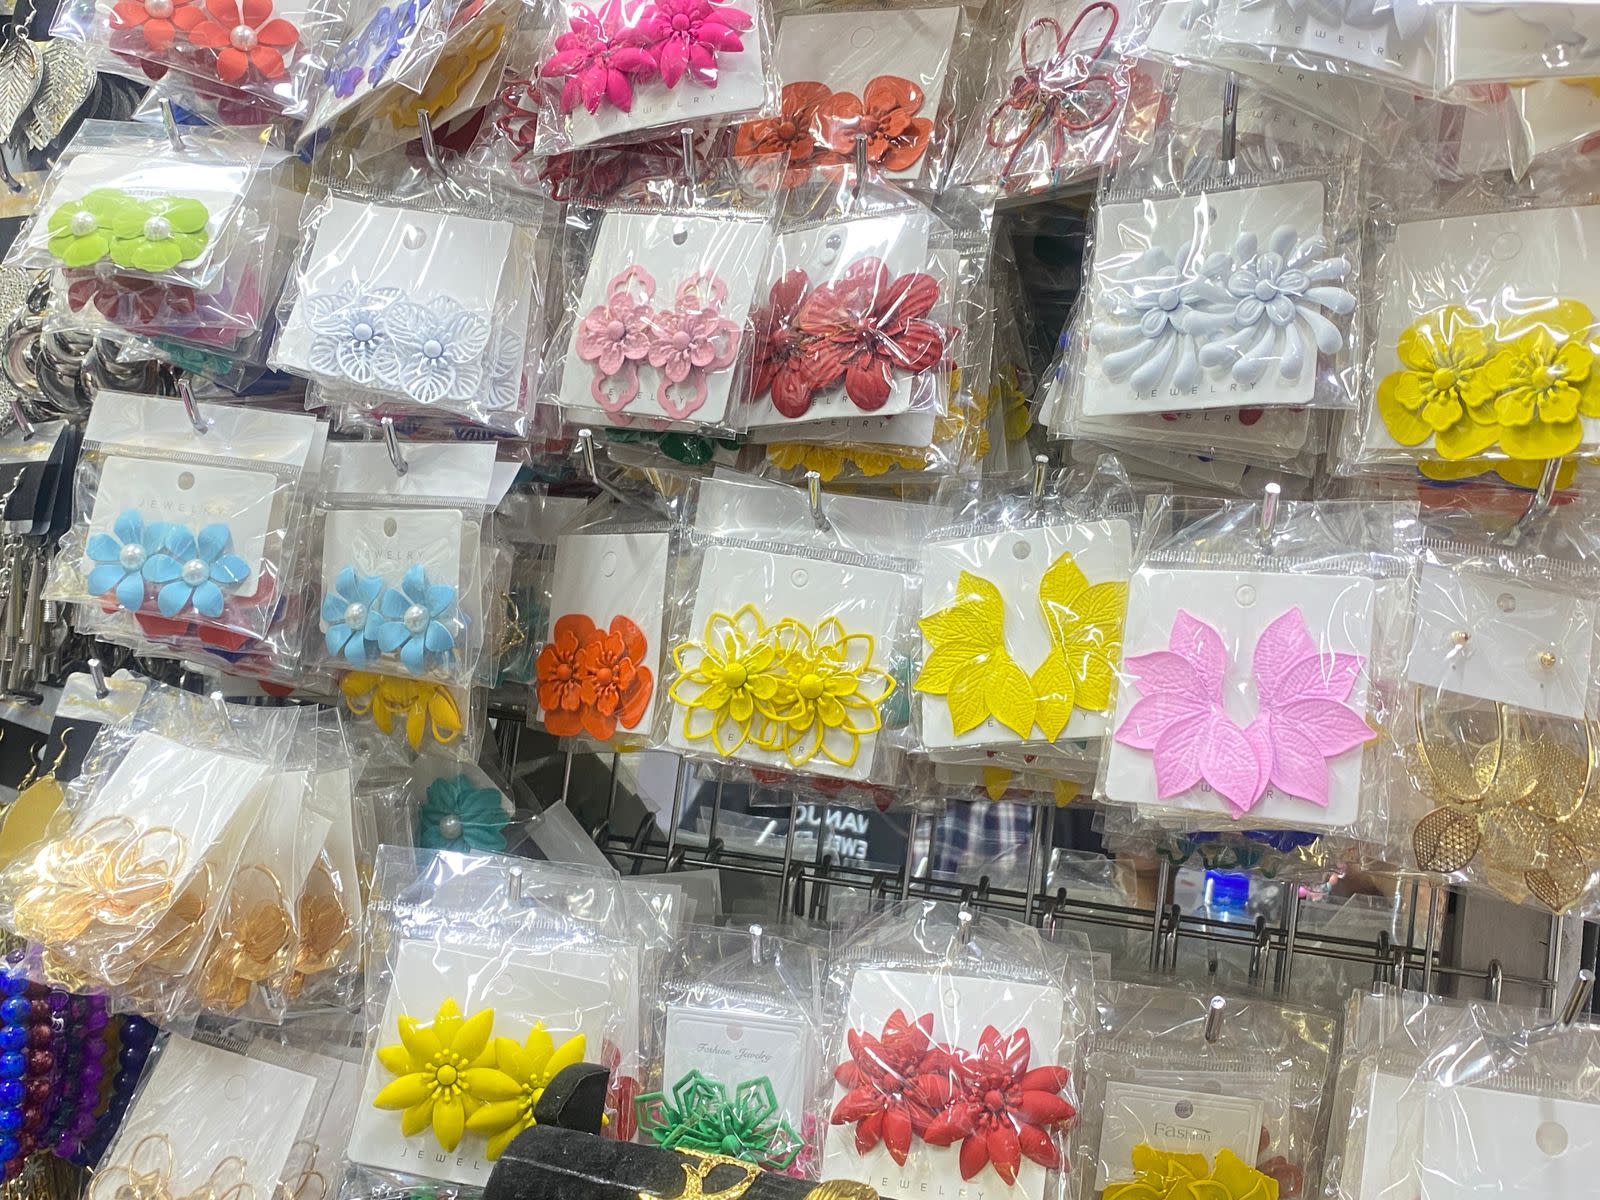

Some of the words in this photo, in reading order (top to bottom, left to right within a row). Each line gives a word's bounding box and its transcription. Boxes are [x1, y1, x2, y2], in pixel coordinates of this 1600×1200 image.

[1276, 25, 1403, 61] JEWELRY
[615, 94, 716, 121] JEWELRY
[1135, 381, 1257, 401] JEWELRY
[696, 1042, 731, 1056] Fashion
[734, 1047, 773, 1064] Jewelry
[1153, 1121, 1212, 1143] Fashion
[401, 1147, 481, 1170] JEWEL
